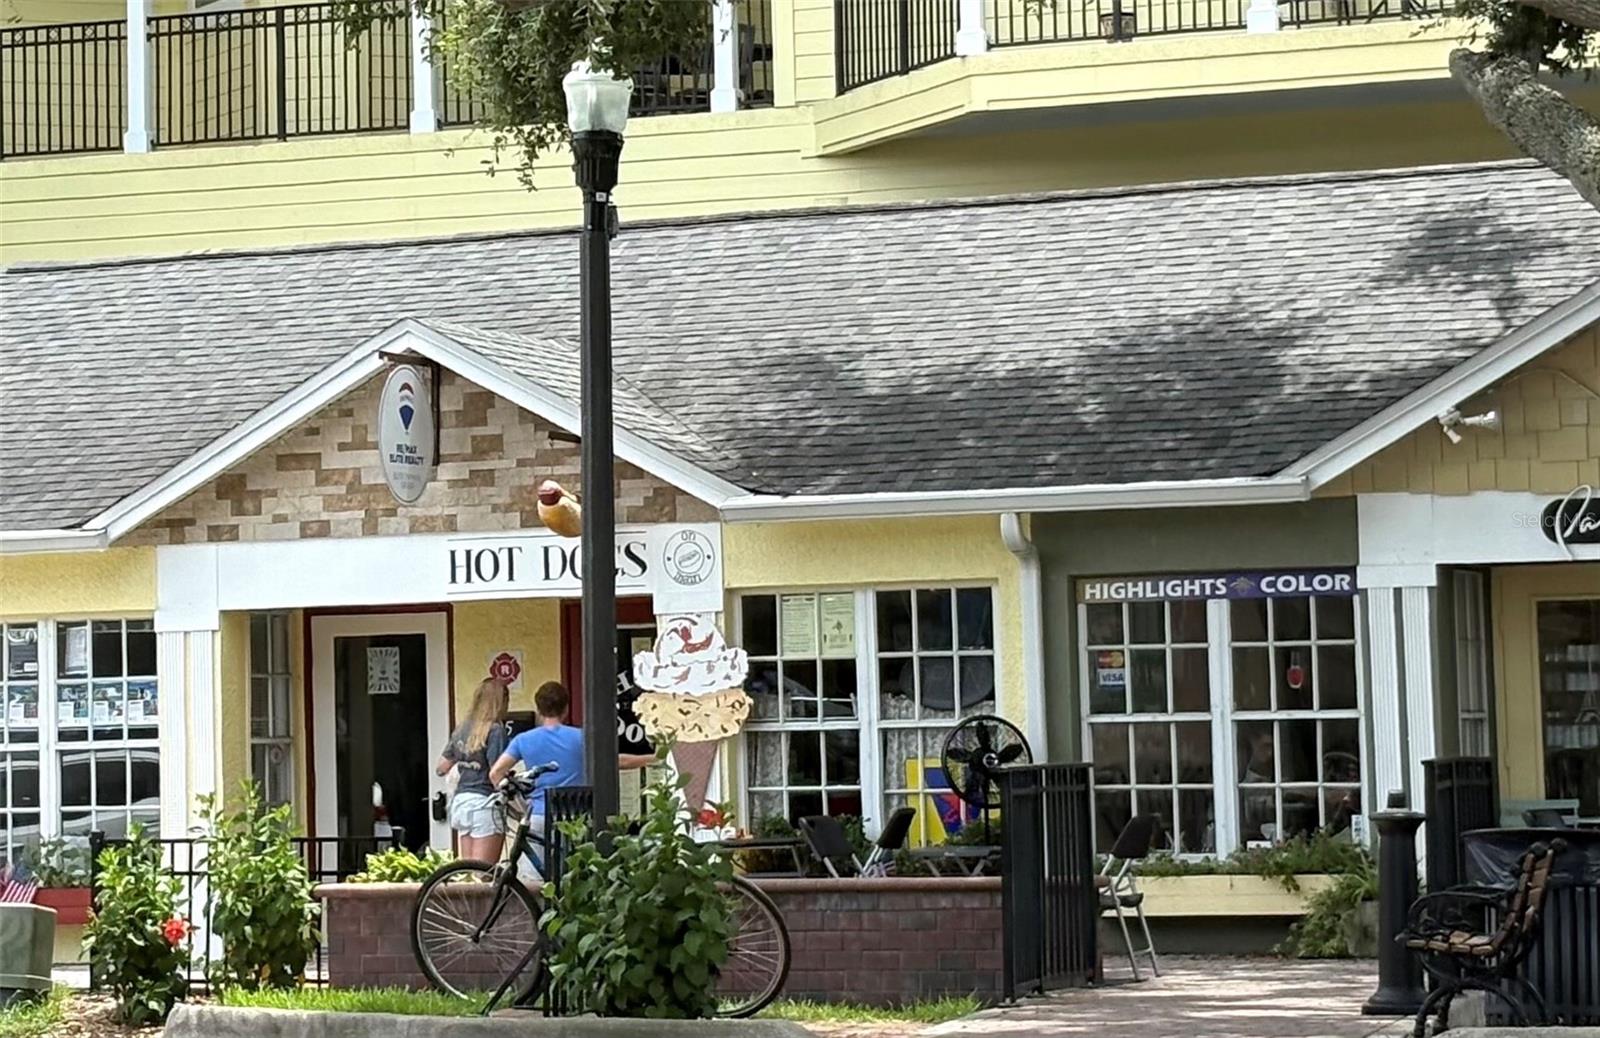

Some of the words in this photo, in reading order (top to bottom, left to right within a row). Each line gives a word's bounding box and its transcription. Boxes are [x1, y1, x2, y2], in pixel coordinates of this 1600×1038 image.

[449, 547, 522, 585] HOT
[1085, 578, 1227, 600] HIGHLIGHTS
[1260, 574, 1351, 593] COLOR
[1102, 672, 1125, 682] VISA
